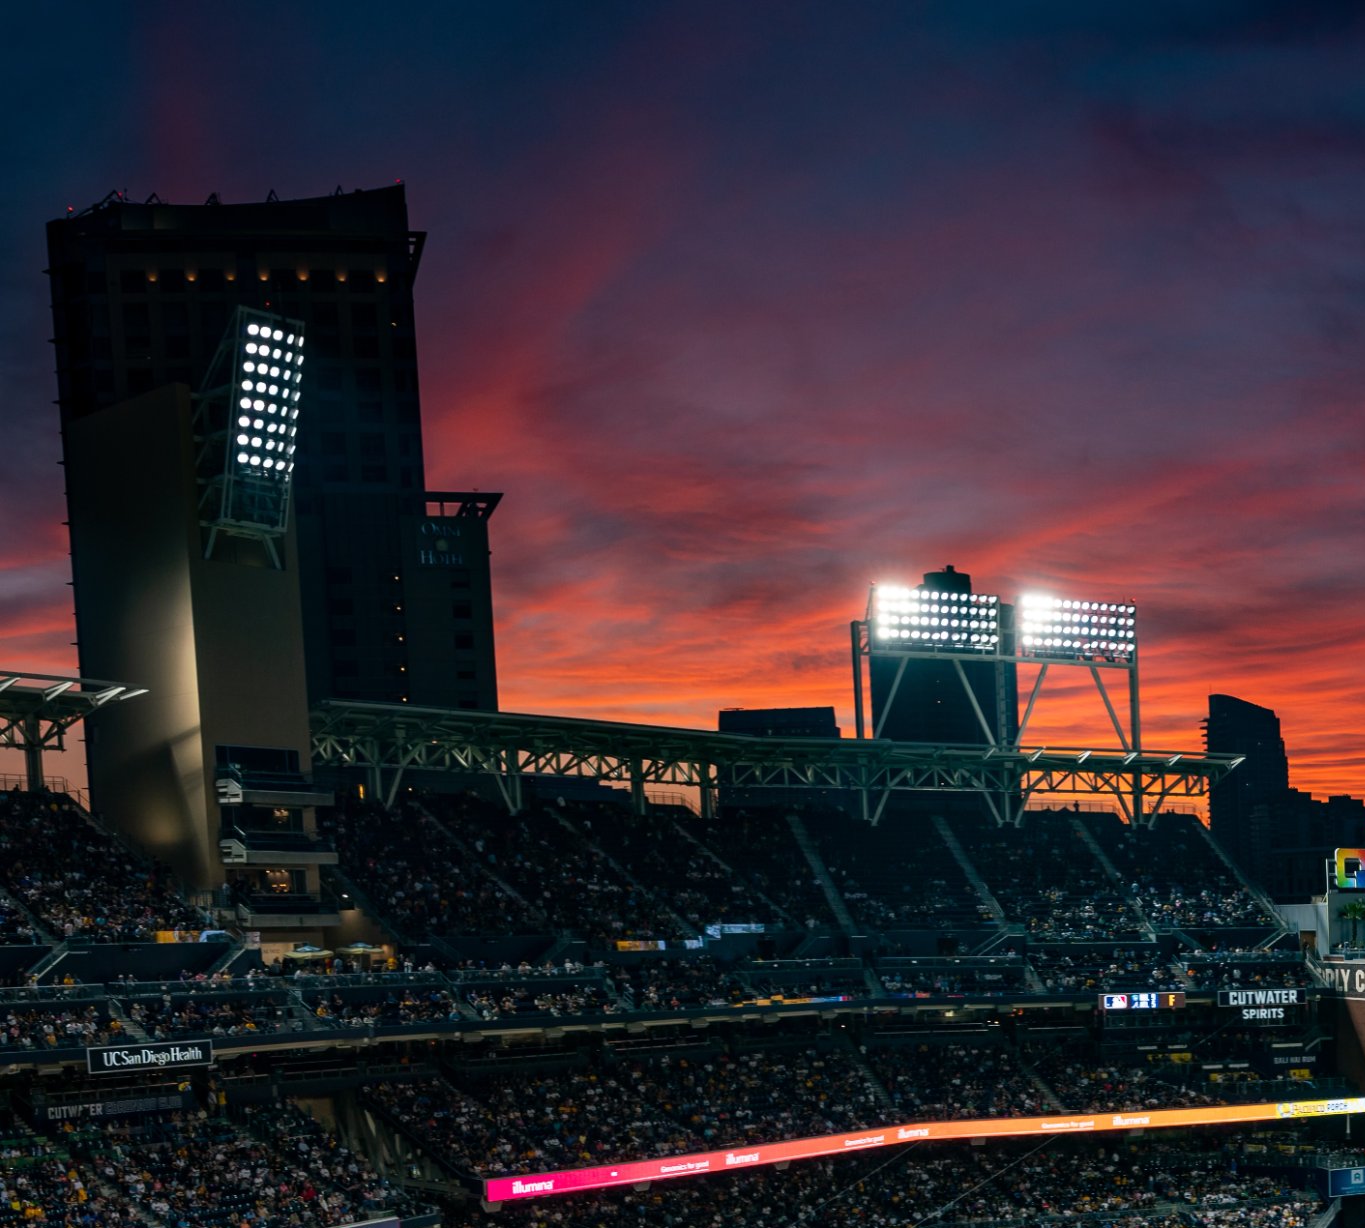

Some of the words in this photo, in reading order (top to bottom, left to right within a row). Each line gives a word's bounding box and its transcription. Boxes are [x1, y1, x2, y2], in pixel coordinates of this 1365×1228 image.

[1229, 990, 1298, 1006] CUTWATER
[1242, 1008, 1284, 1019] SPIRITS
[103, 1052, 122, 1067] UC
[122, 1051, 141, 1065] San
[142, 1050, 170, 1065] Diego
[171, 1047, 202, 1061] Health
[1112, 1115, 1151, 1127] illumina
[725, 1151, 760, 1165] illumina
[512, 1179, 554, 1196] illumina
